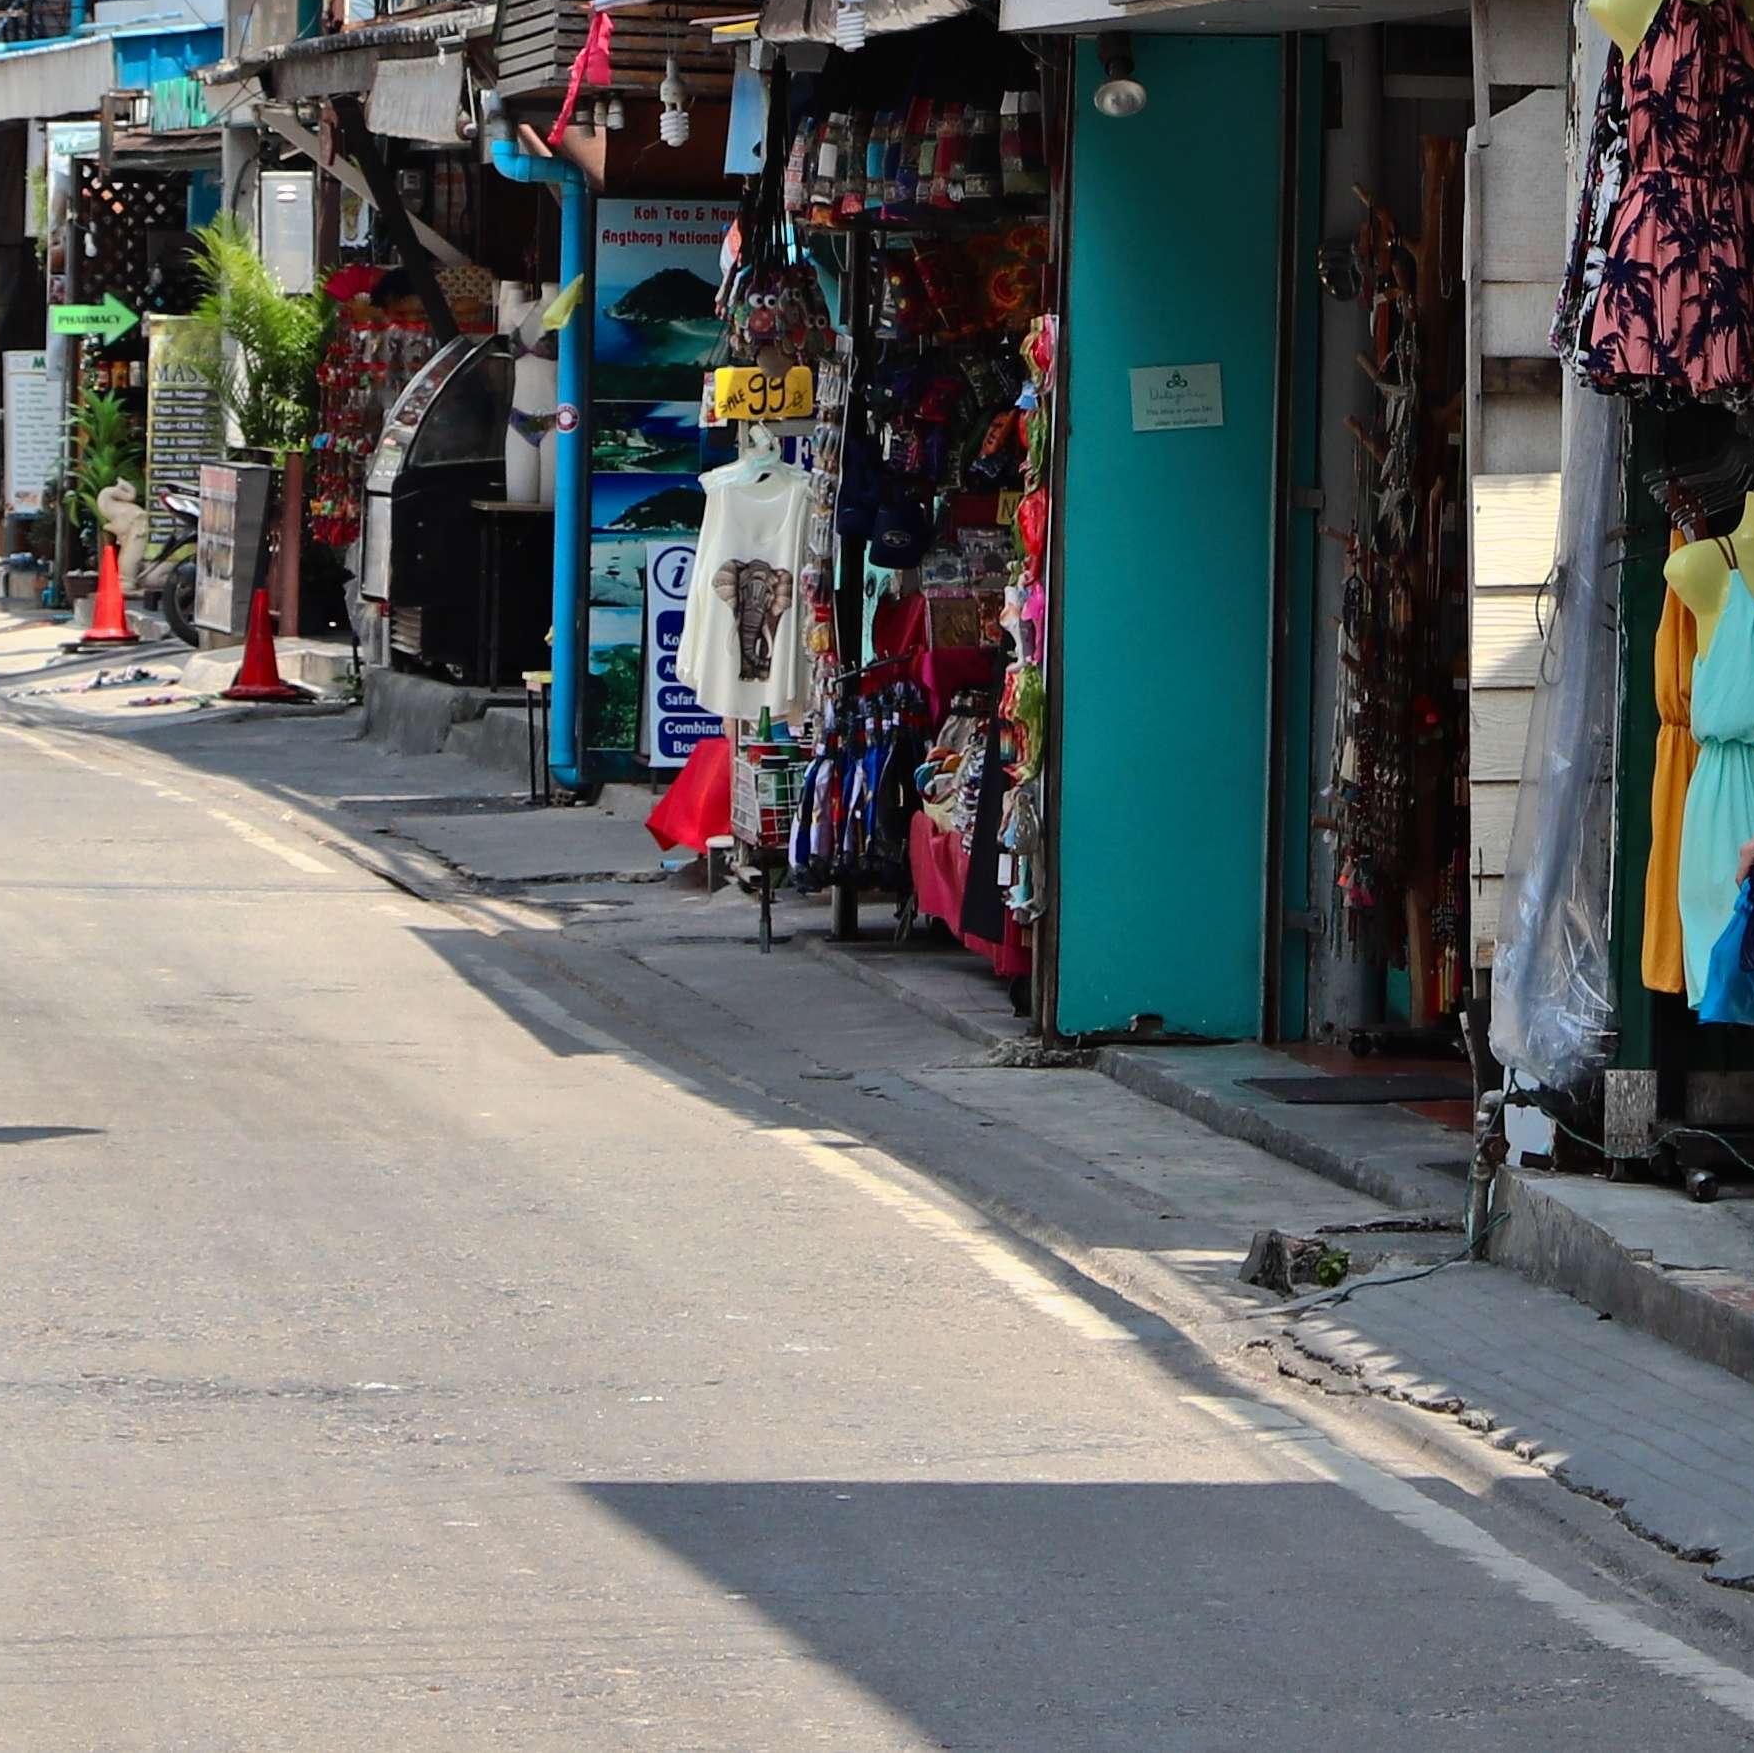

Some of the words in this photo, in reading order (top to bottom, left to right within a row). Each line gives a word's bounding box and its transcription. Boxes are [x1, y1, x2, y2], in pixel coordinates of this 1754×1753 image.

[634, 206, 658, 221] Koh
[666, 206, 689, 221] Tao
[695, 206, 705, 221] &
[602, 229, 663, 246] Angthong
[58, 313, 122, 325] PHARMACY
[718, 389, 746, 414] SALE
[748, 373, 785, 415] 99
